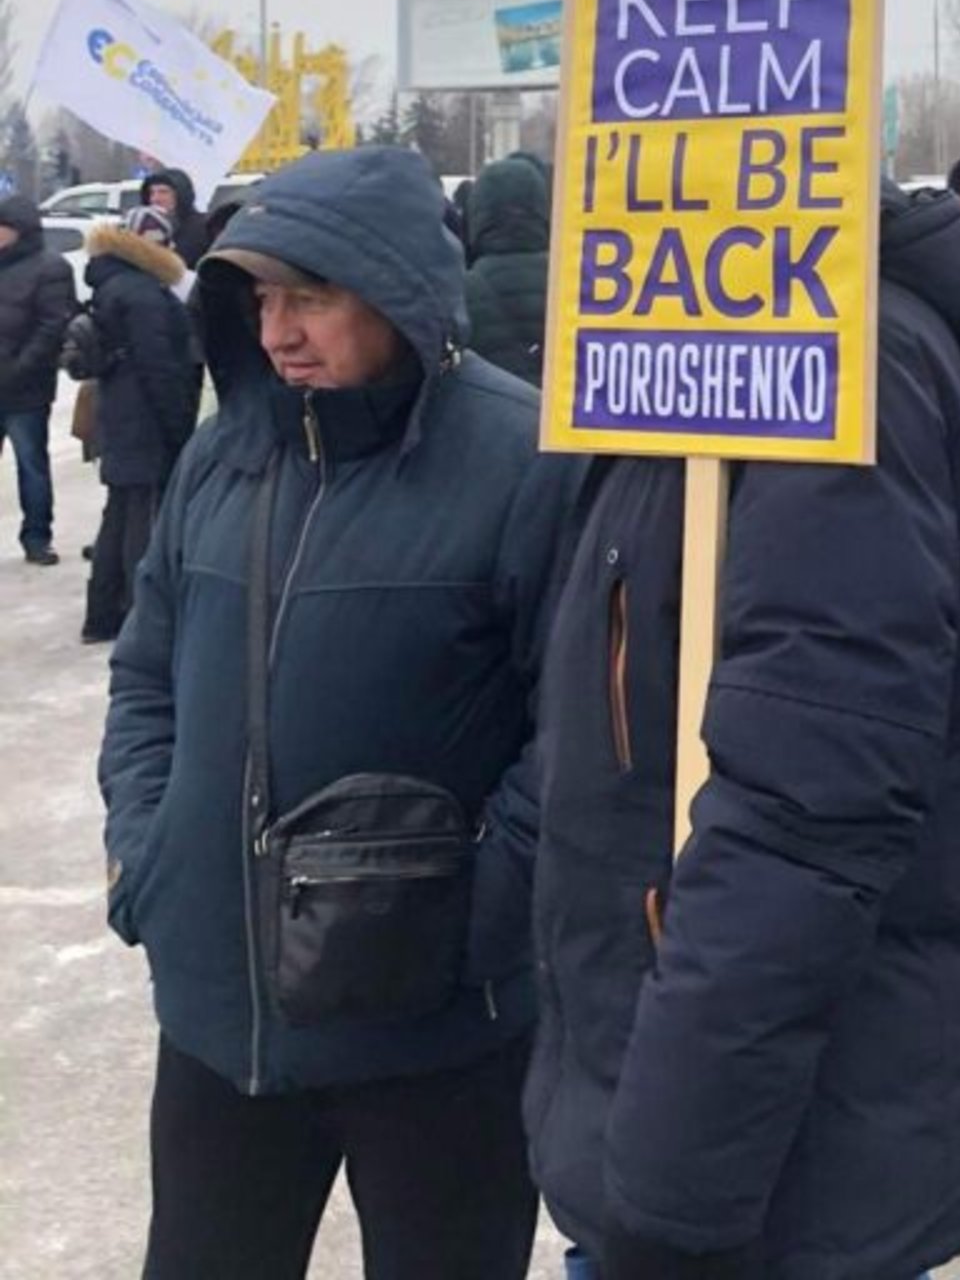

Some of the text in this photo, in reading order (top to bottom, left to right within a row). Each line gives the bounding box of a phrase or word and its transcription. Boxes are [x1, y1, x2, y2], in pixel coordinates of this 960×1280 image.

[613, 39, 822, 118] CALM
[582, 126, 846, 213] I'LL BE
[578, 225, 840, 319] BACK
[583, 342, 827, 424] POROSHENKO
